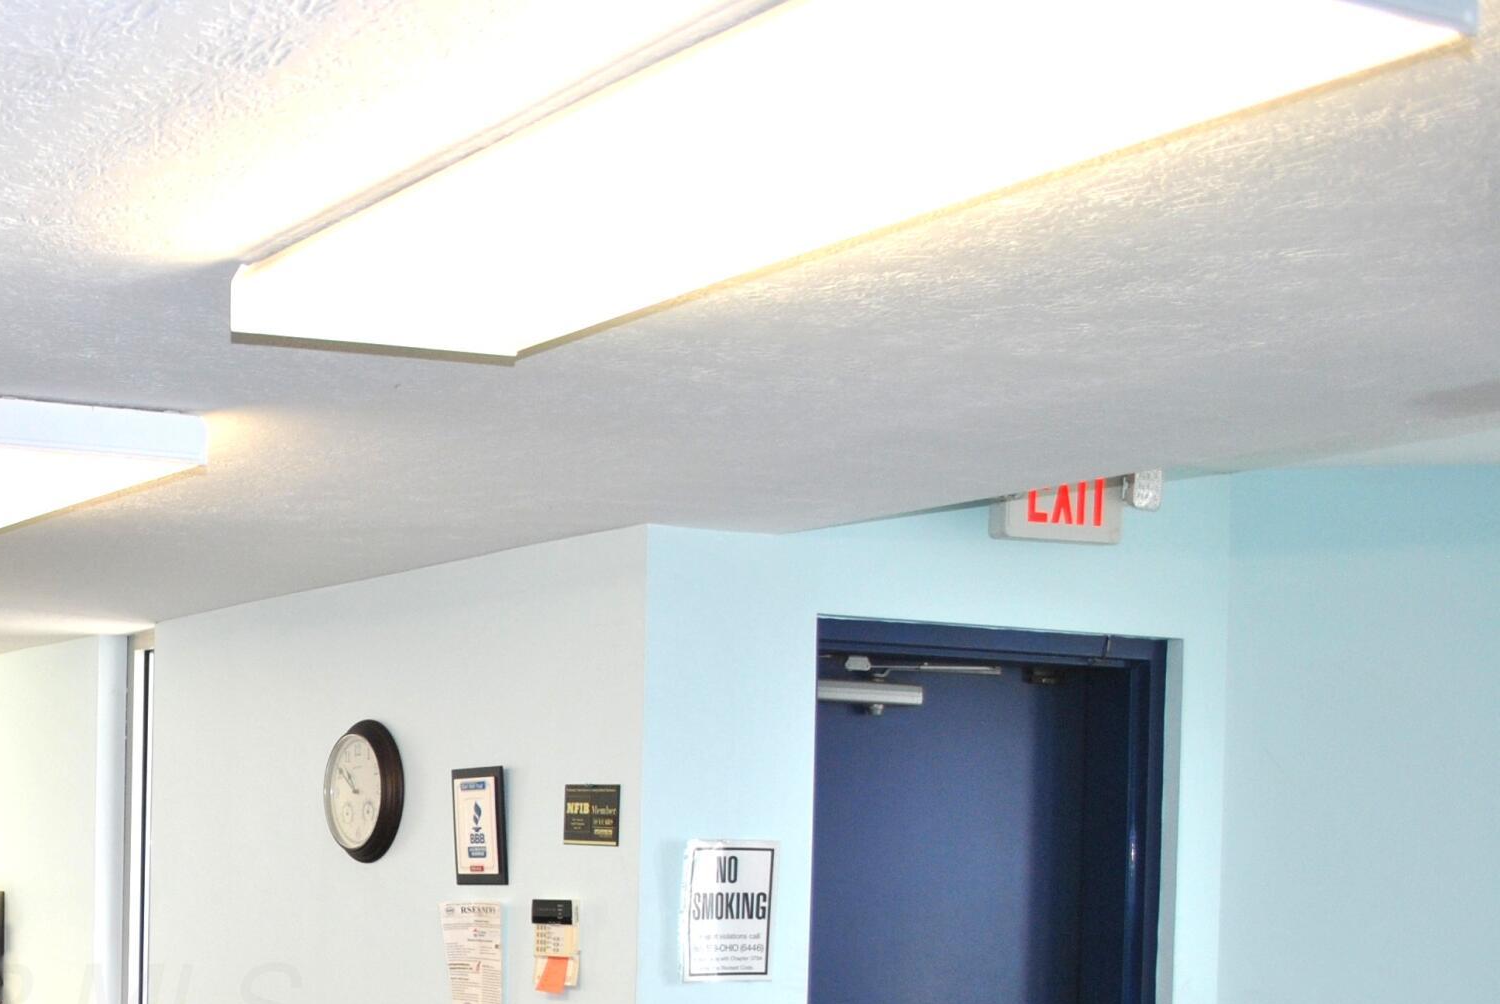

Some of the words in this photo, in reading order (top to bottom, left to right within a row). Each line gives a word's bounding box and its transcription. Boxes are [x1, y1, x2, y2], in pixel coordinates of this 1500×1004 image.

[566, 802, 590, 814] NFIB
[716, 855, 738, 884] NO
[692, 891, 767, 921] SMOKING
